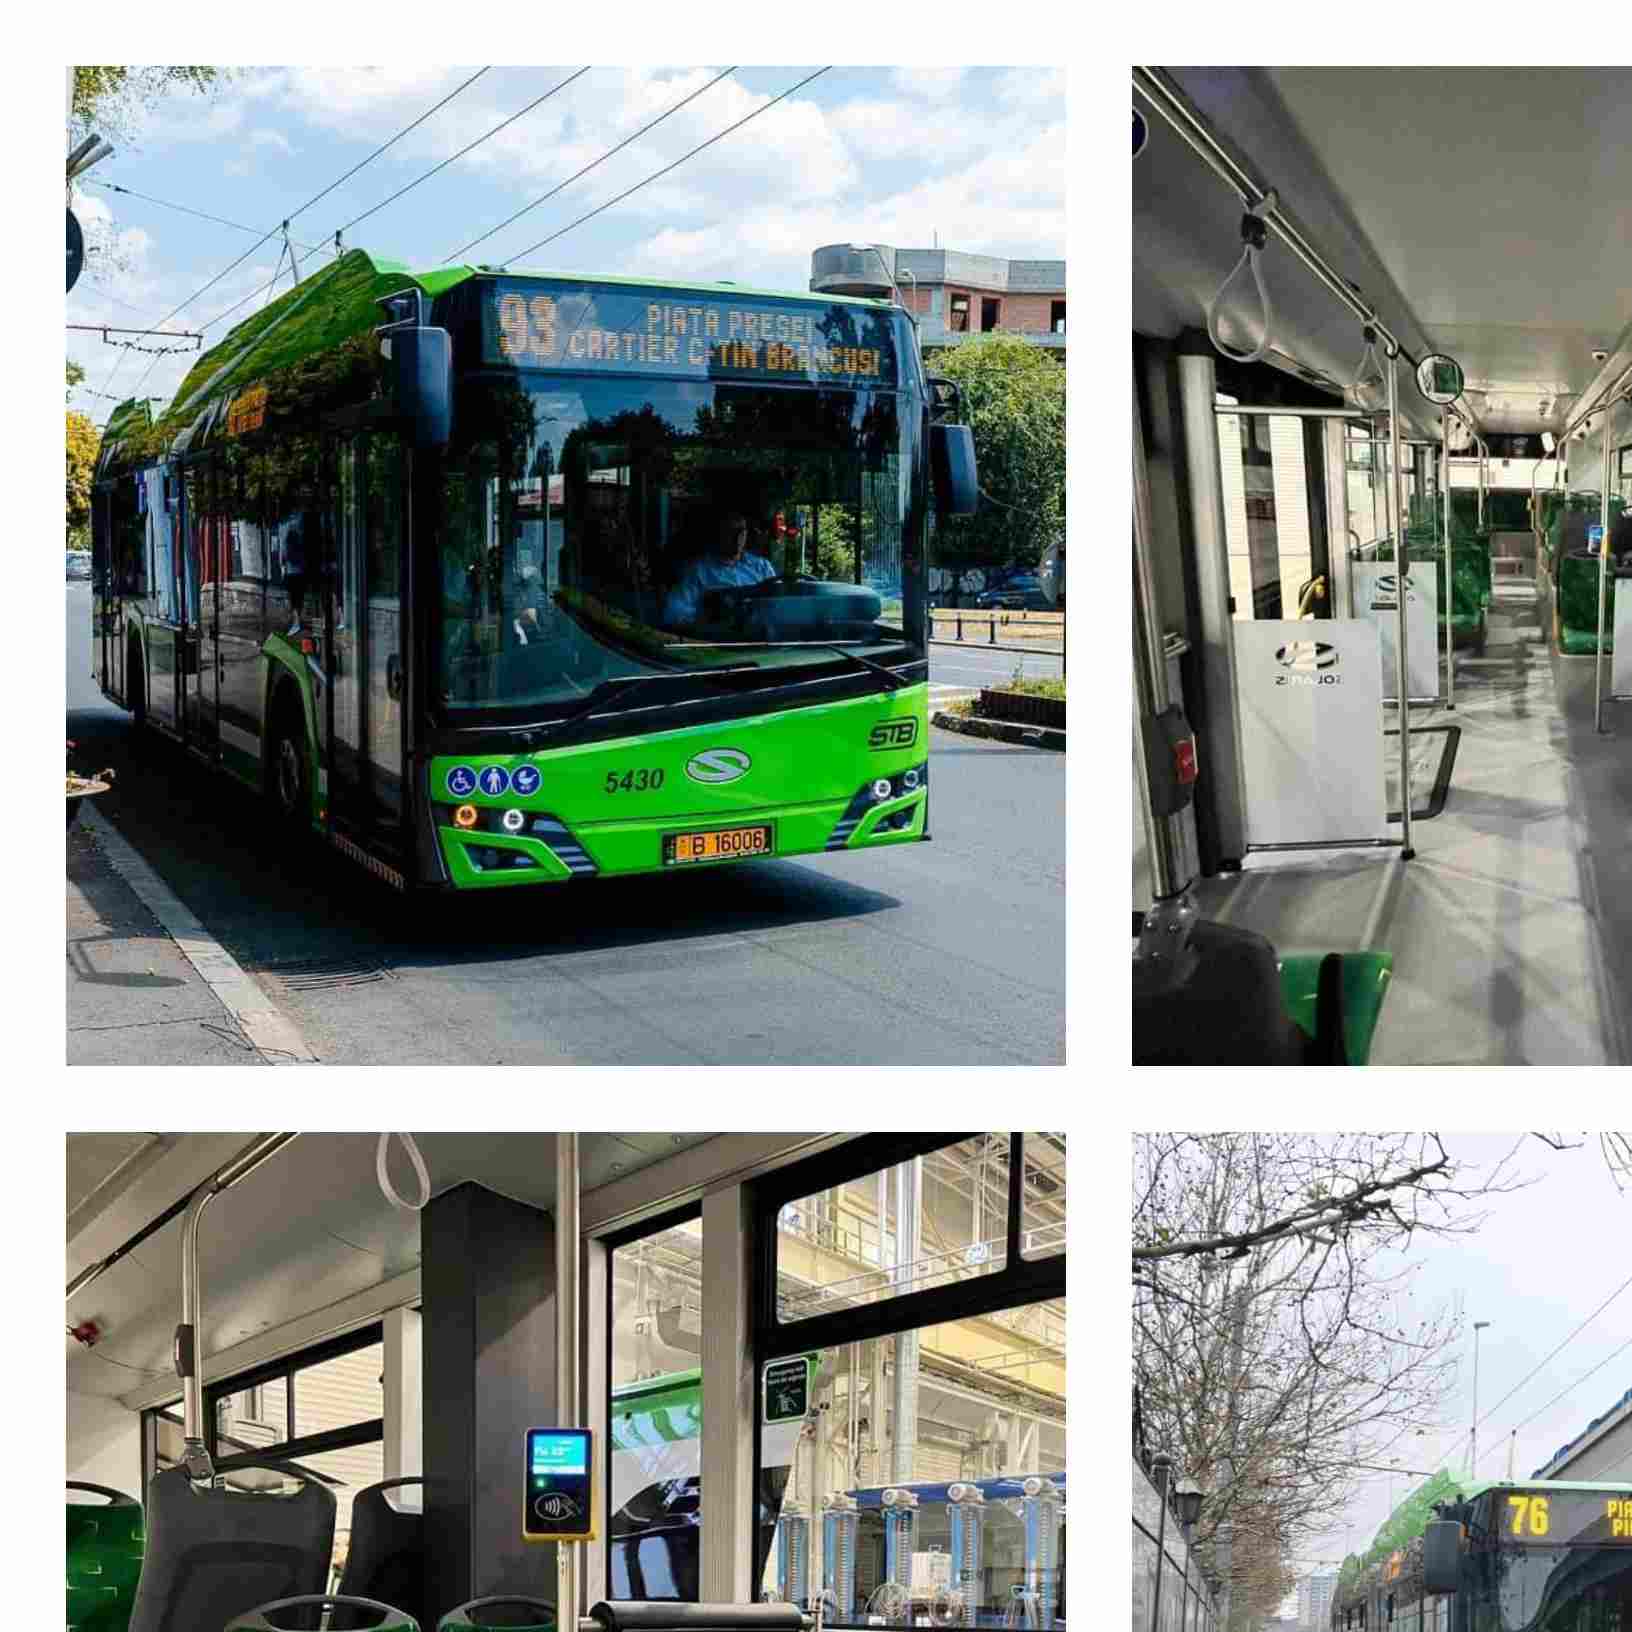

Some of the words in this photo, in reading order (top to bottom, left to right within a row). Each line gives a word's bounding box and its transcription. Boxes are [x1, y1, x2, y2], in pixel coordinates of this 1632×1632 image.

[498, 294, 557, 357] 93
[648, 304, 720, 337] PIATA
[728, 311, 816, 343] PRESEI
[568, 329, 681, 363] CARTIER
[867, 720, 915, 749] STB
[605, 768, 664, 794] 5430
[693, 836, 705, 855] B
[715, 831, 763, 853] 16006
[1508, 1496, 1549, 1535] 76
